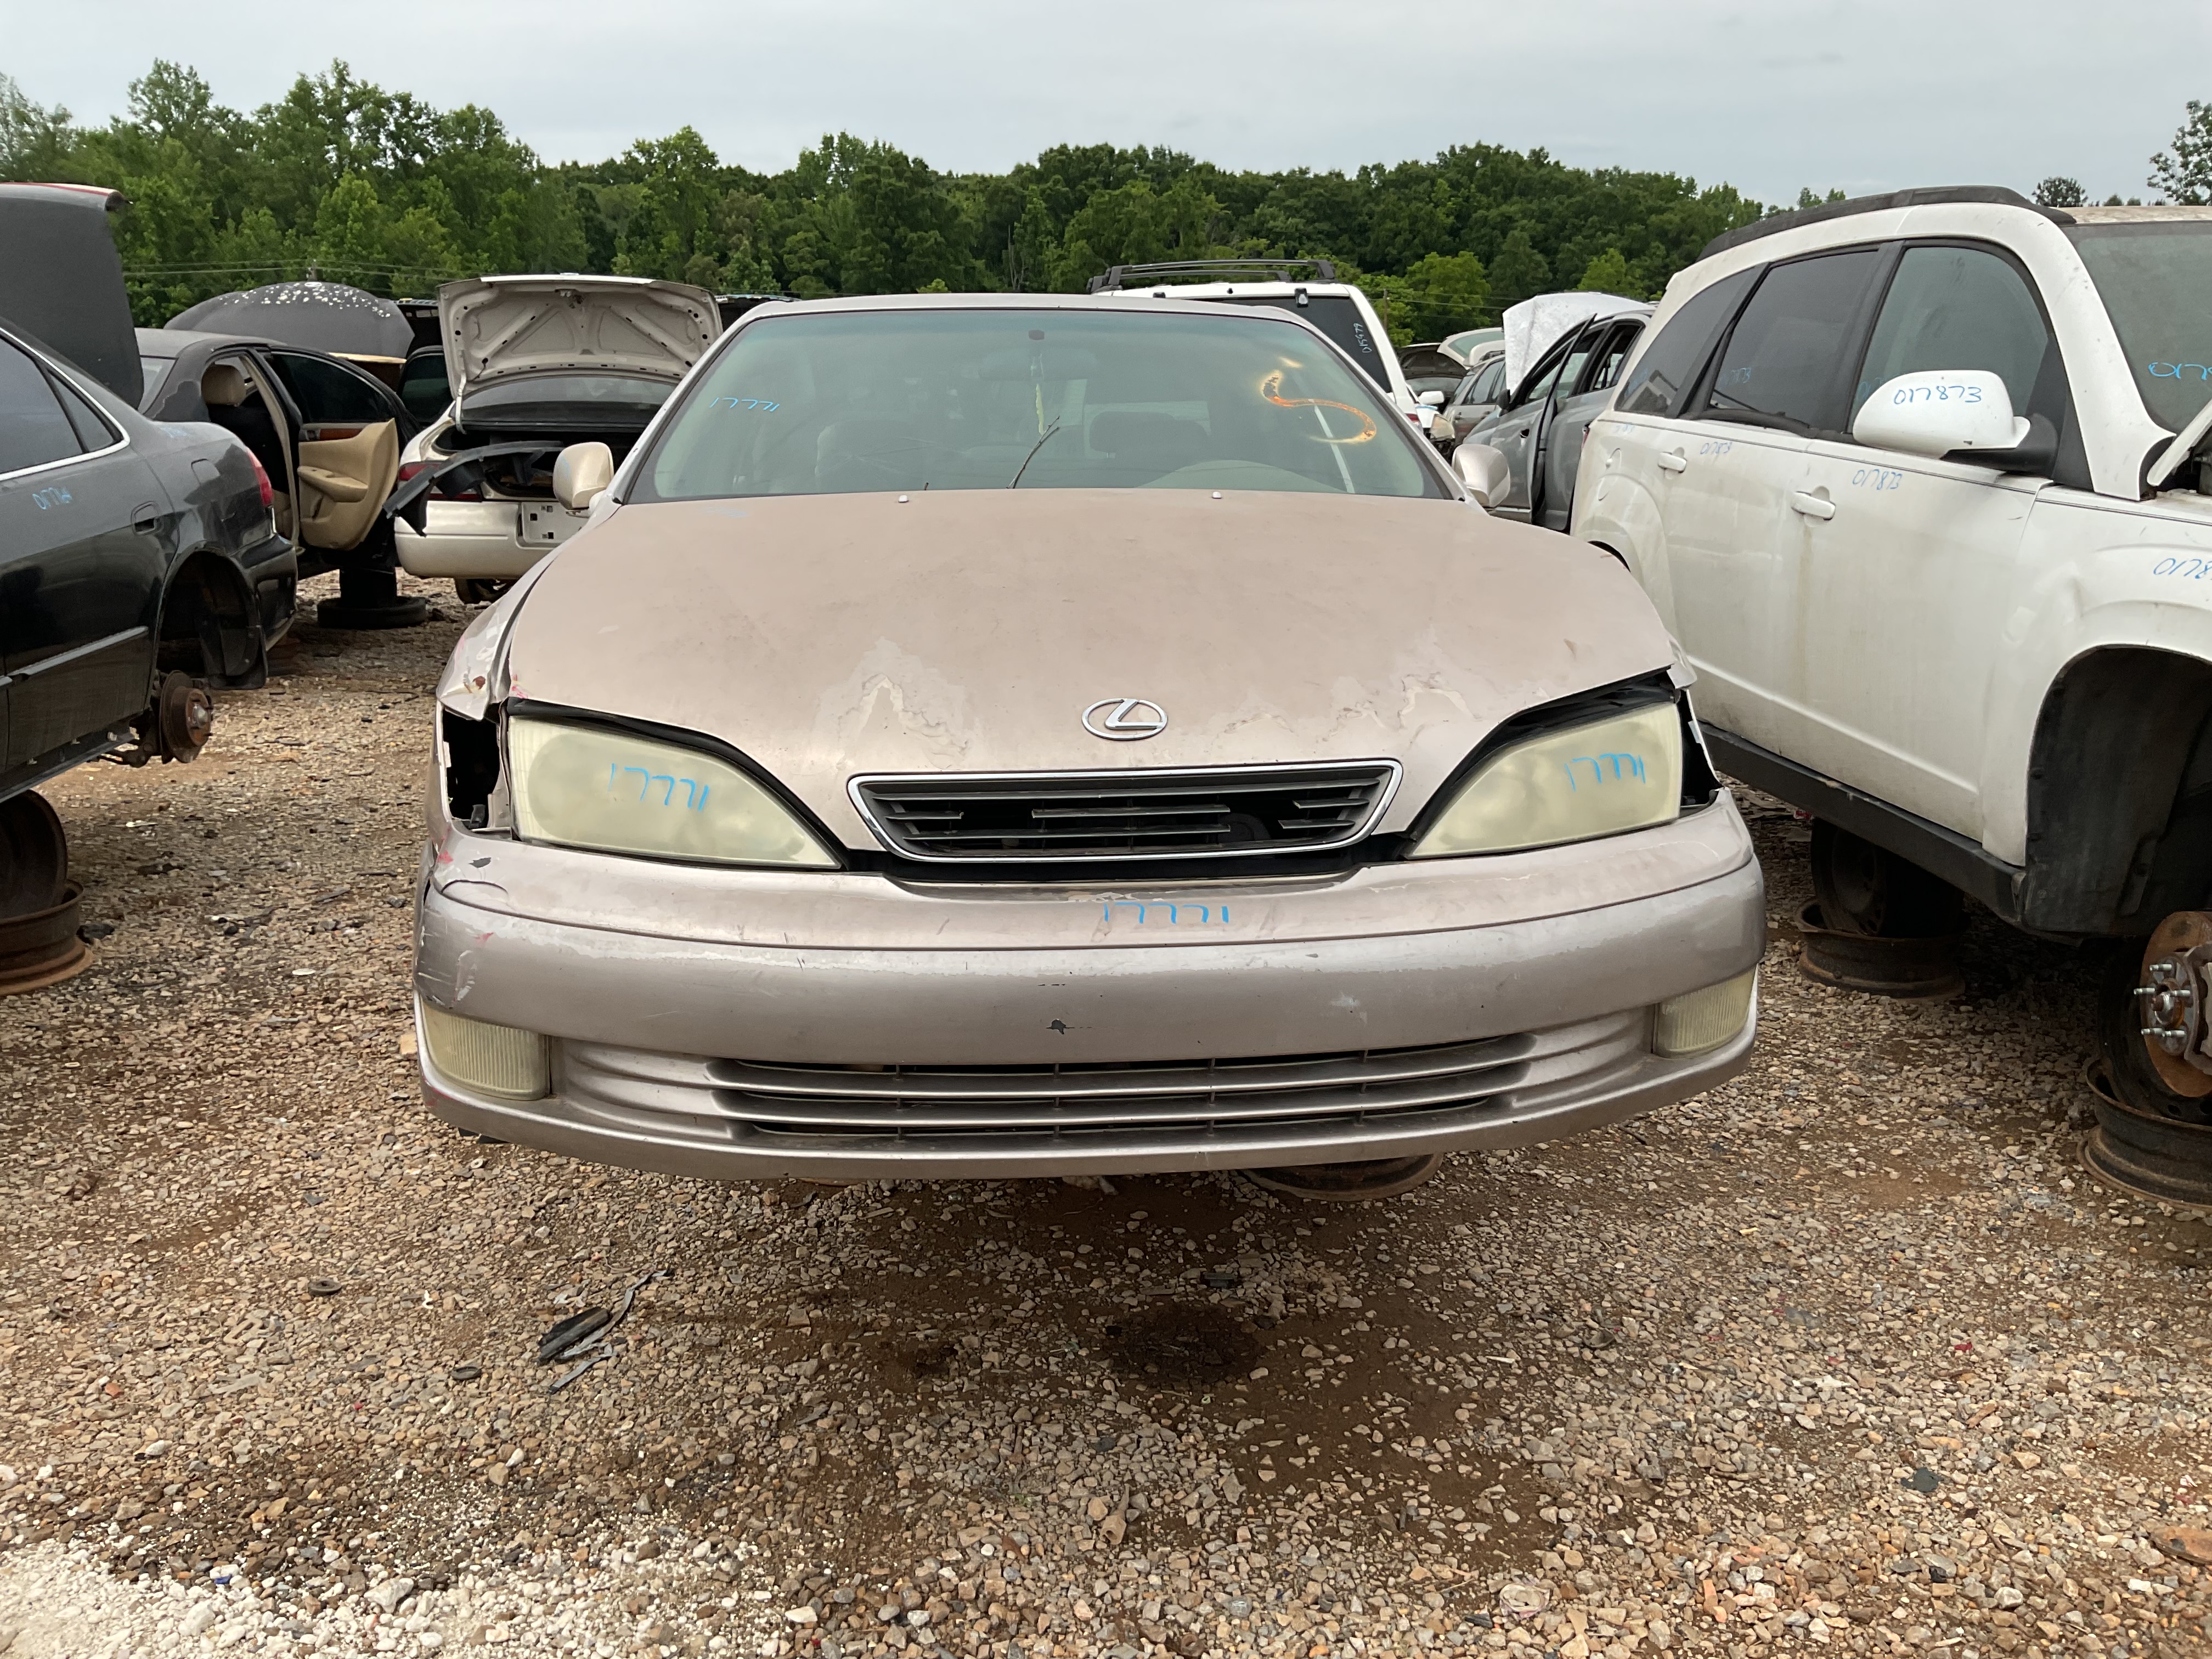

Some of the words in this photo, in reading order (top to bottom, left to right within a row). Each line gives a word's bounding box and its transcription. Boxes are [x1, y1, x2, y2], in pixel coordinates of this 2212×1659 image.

[2148, 362, 2212, 381] 017
[709, 397, 780, 412] 17771
[1894, 385, 1982, 405] 017873
[1852, 469, 1903, 490] 017873
[1564, 752, 1646, 792] 17771
[607, 763, 709, 811] 17771
[1103, 901, 1229, 924] 17771
